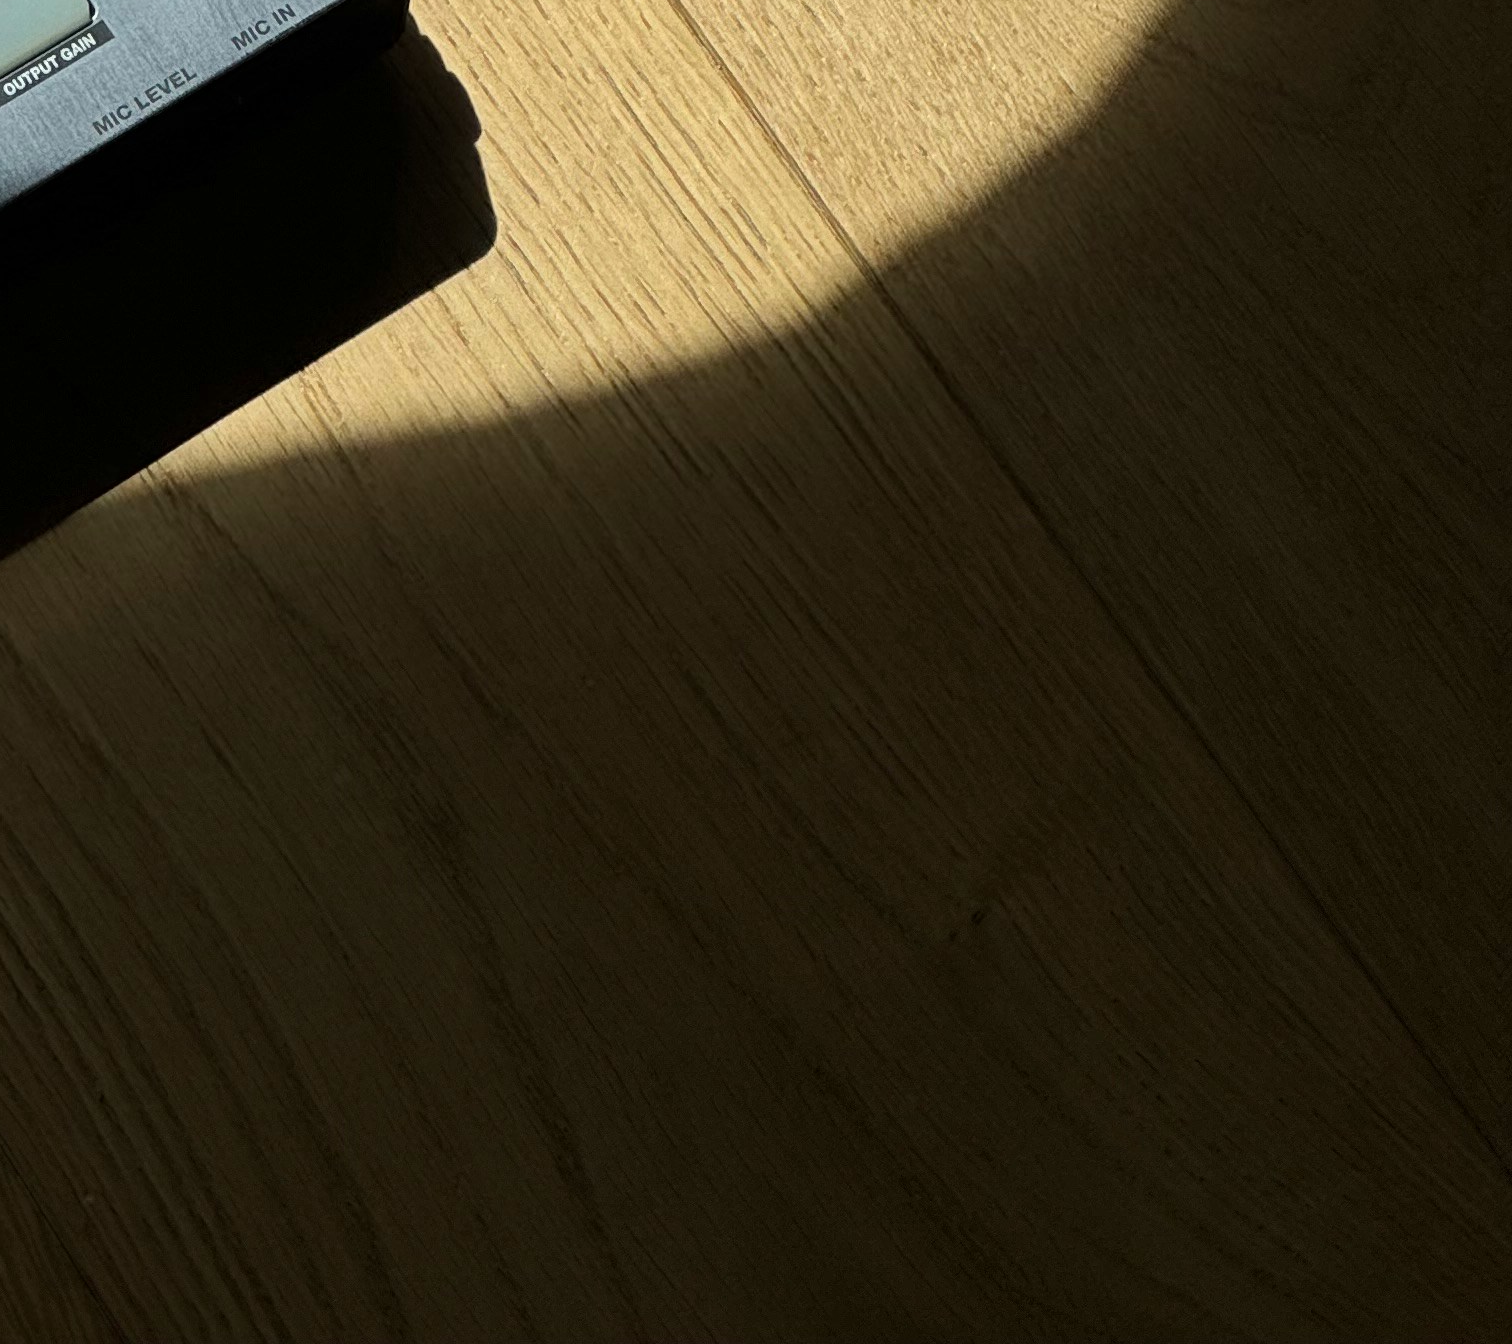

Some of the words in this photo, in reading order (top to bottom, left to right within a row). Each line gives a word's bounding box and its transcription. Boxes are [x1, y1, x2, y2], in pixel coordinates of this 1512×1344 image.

[1, 54, 62, 98] OUTPUT
[58, 32, 98, 63] GAIN
[91, 101, 136, 136] MIC
[131, 63, 198, 111] LEVEL
